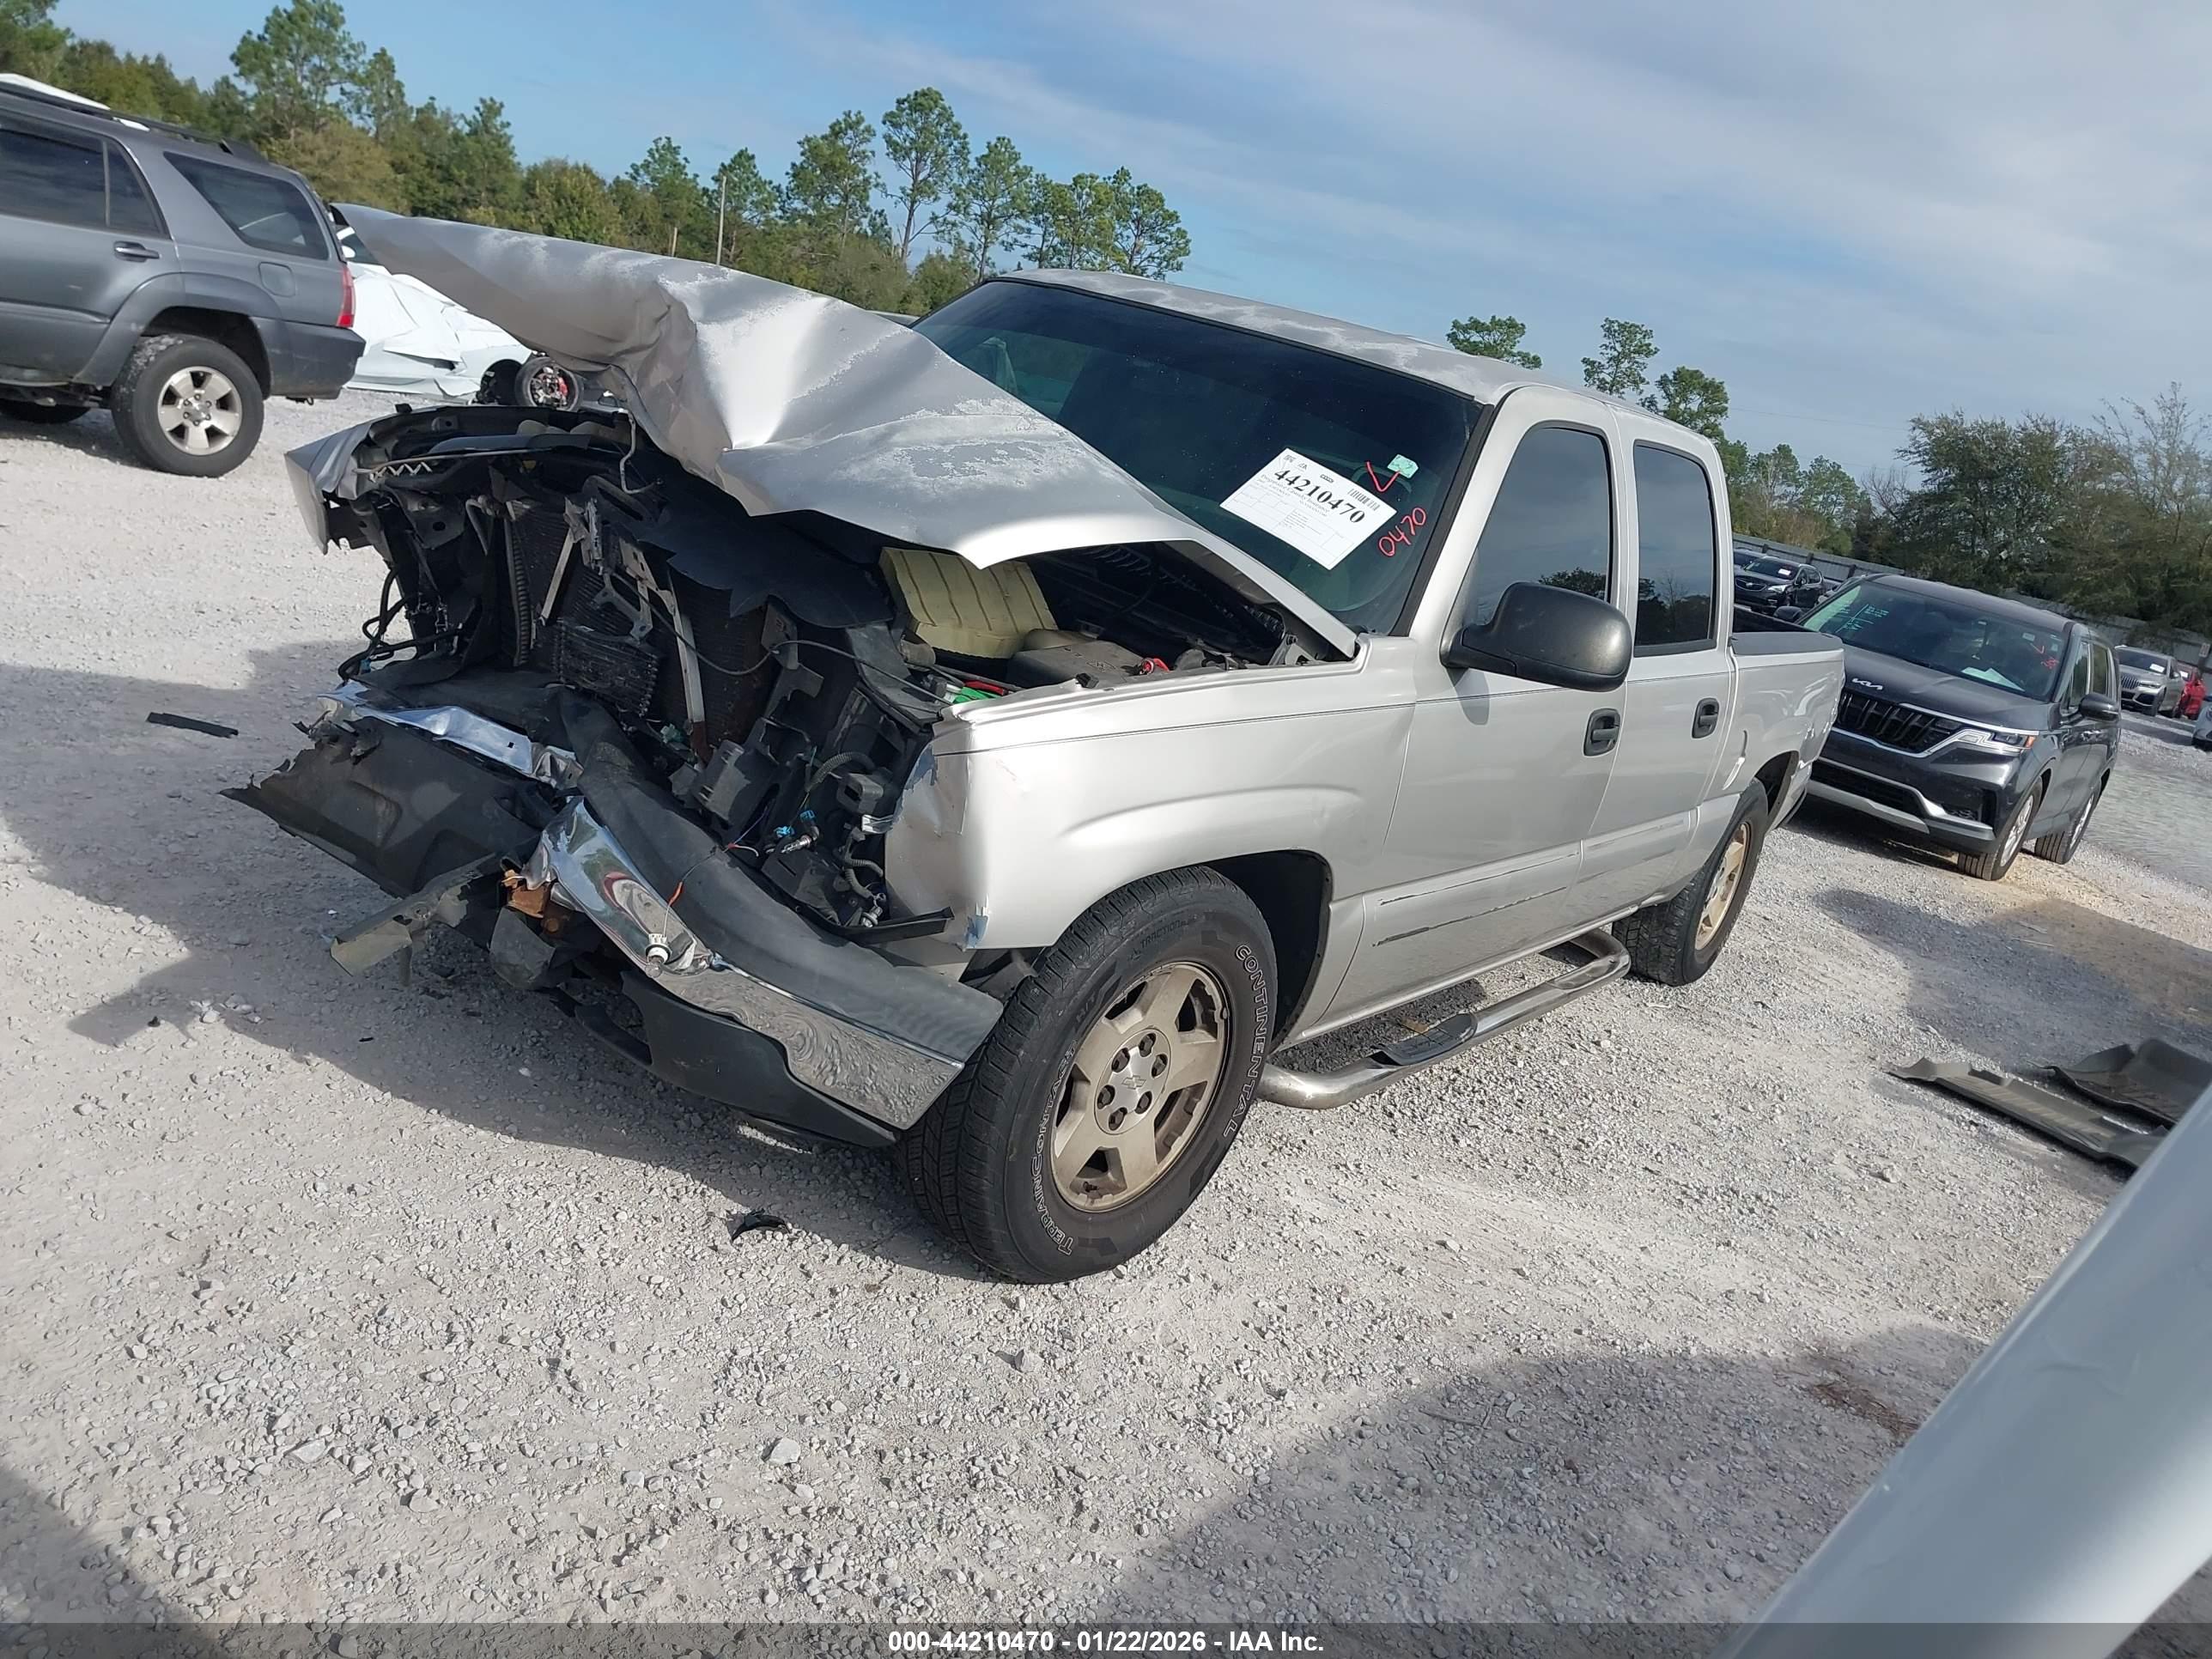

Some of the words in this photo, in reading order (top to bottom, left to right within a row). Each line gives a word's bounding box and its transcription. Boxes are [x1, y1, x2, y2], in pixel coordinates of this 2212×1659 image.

[1274, 470, 1365, 523] 44210470
[1378, 507, 1427, 557] 0470
[1224, 945, 1268, 1138] CONTINENTAL
